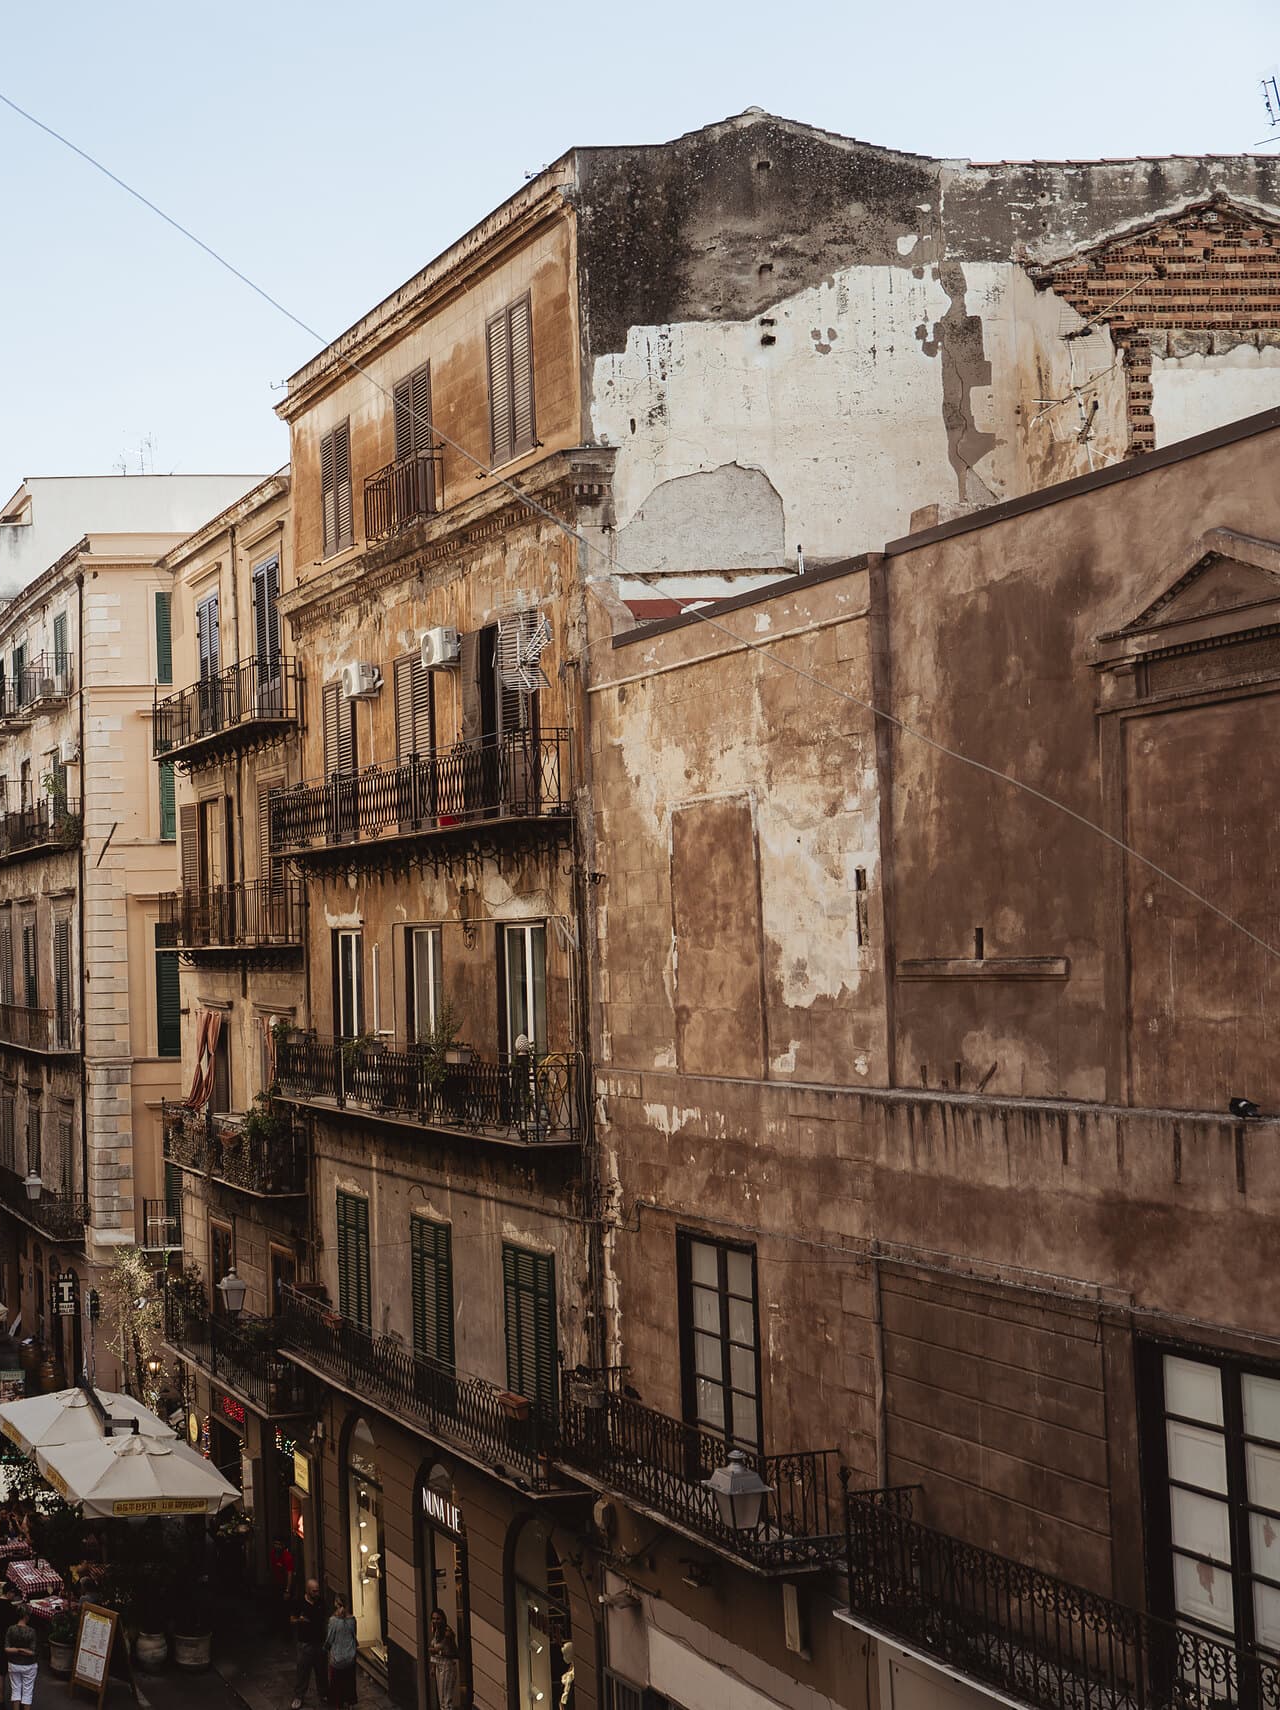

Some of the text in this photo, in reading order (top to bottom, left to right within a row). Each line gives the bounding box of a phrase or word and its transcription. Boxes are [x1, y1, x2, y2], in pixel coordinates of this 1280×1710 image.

[116, 1502, 156, 1513] OSTERIA
[422, 1487, 461, 1534] NUNA LIE
